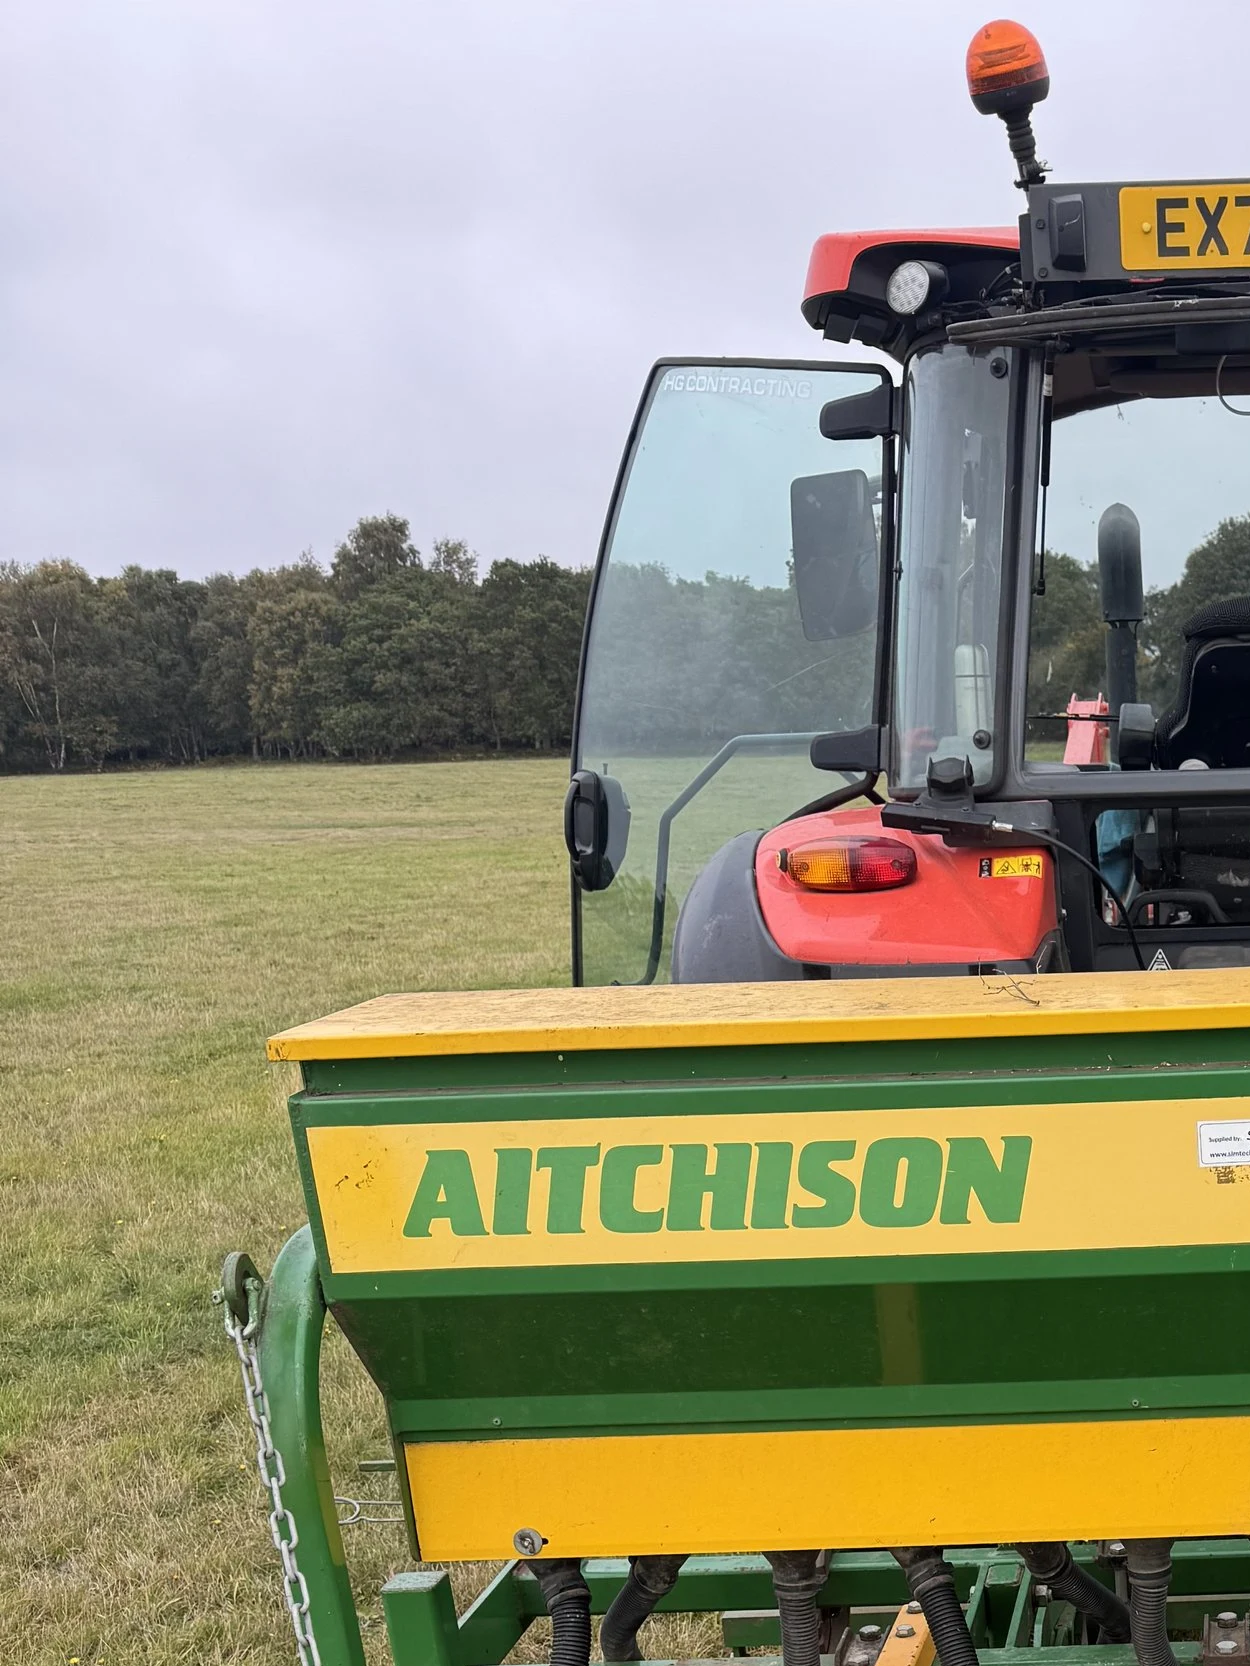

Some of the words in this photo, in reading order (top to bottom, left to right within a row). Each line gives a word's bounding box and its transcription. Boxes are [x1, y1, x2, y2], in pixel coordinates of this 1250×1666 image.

[664, 375, 685, 391] HG
[686, 375, 812, 397] CONTRACTING
[402, 1135, 1034, 1238] AITCHISON
